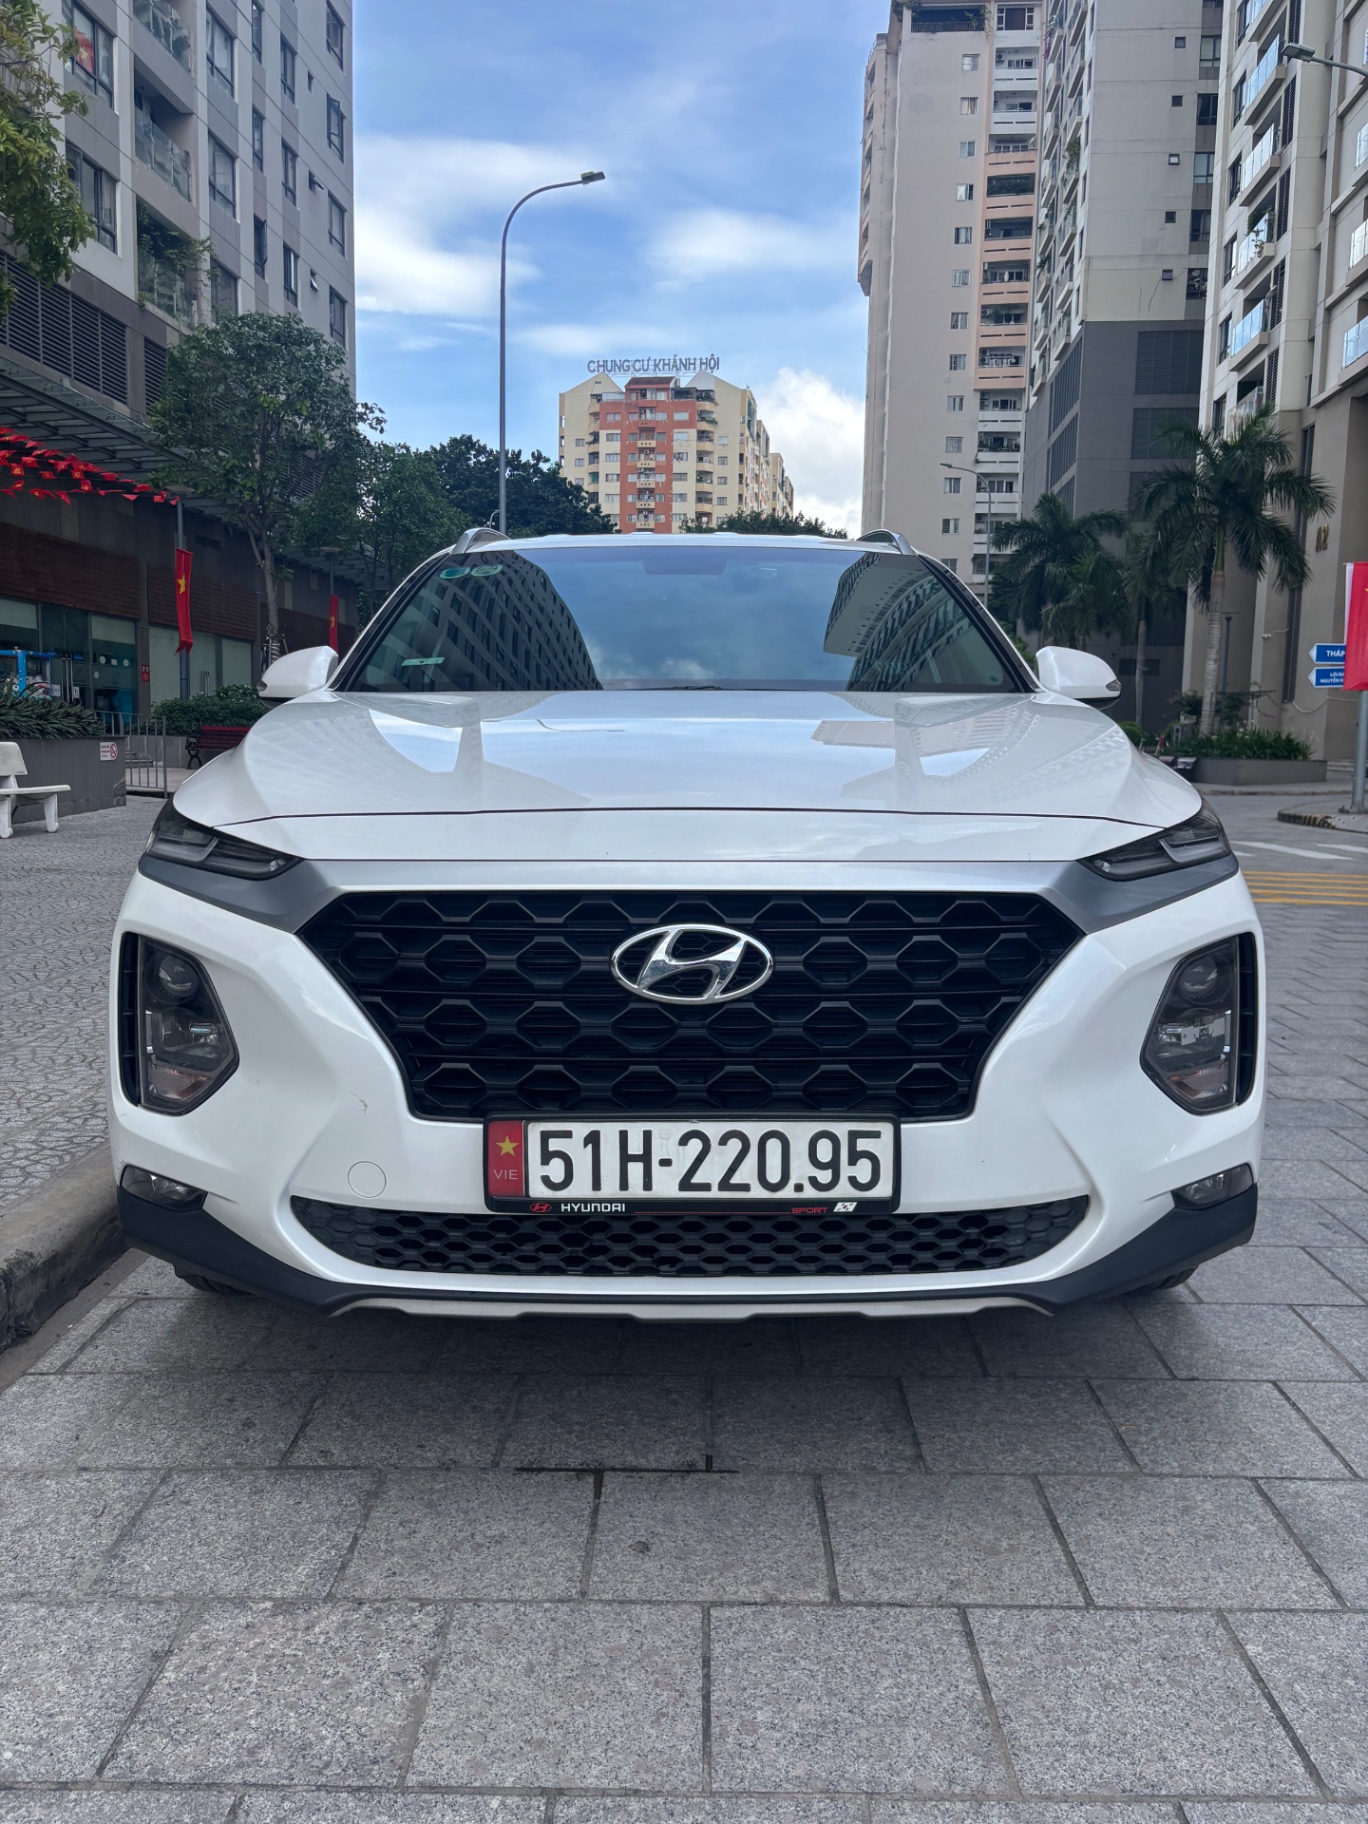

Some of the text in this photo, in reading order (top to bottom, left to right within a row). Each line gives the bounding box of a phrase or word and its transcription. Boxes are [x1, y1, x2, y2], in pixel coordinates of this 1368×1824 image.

[587, 353, 720, 374] CHUNG CƯ KHÁNH HỘI
[1326, 649, 1346, 657] THÁP
[540, 1129, 882, 1192] 51H-220.95
[493, 1169, 518, 1180] VIE
[561, 1203, 626, 1212] HYUNDAI
